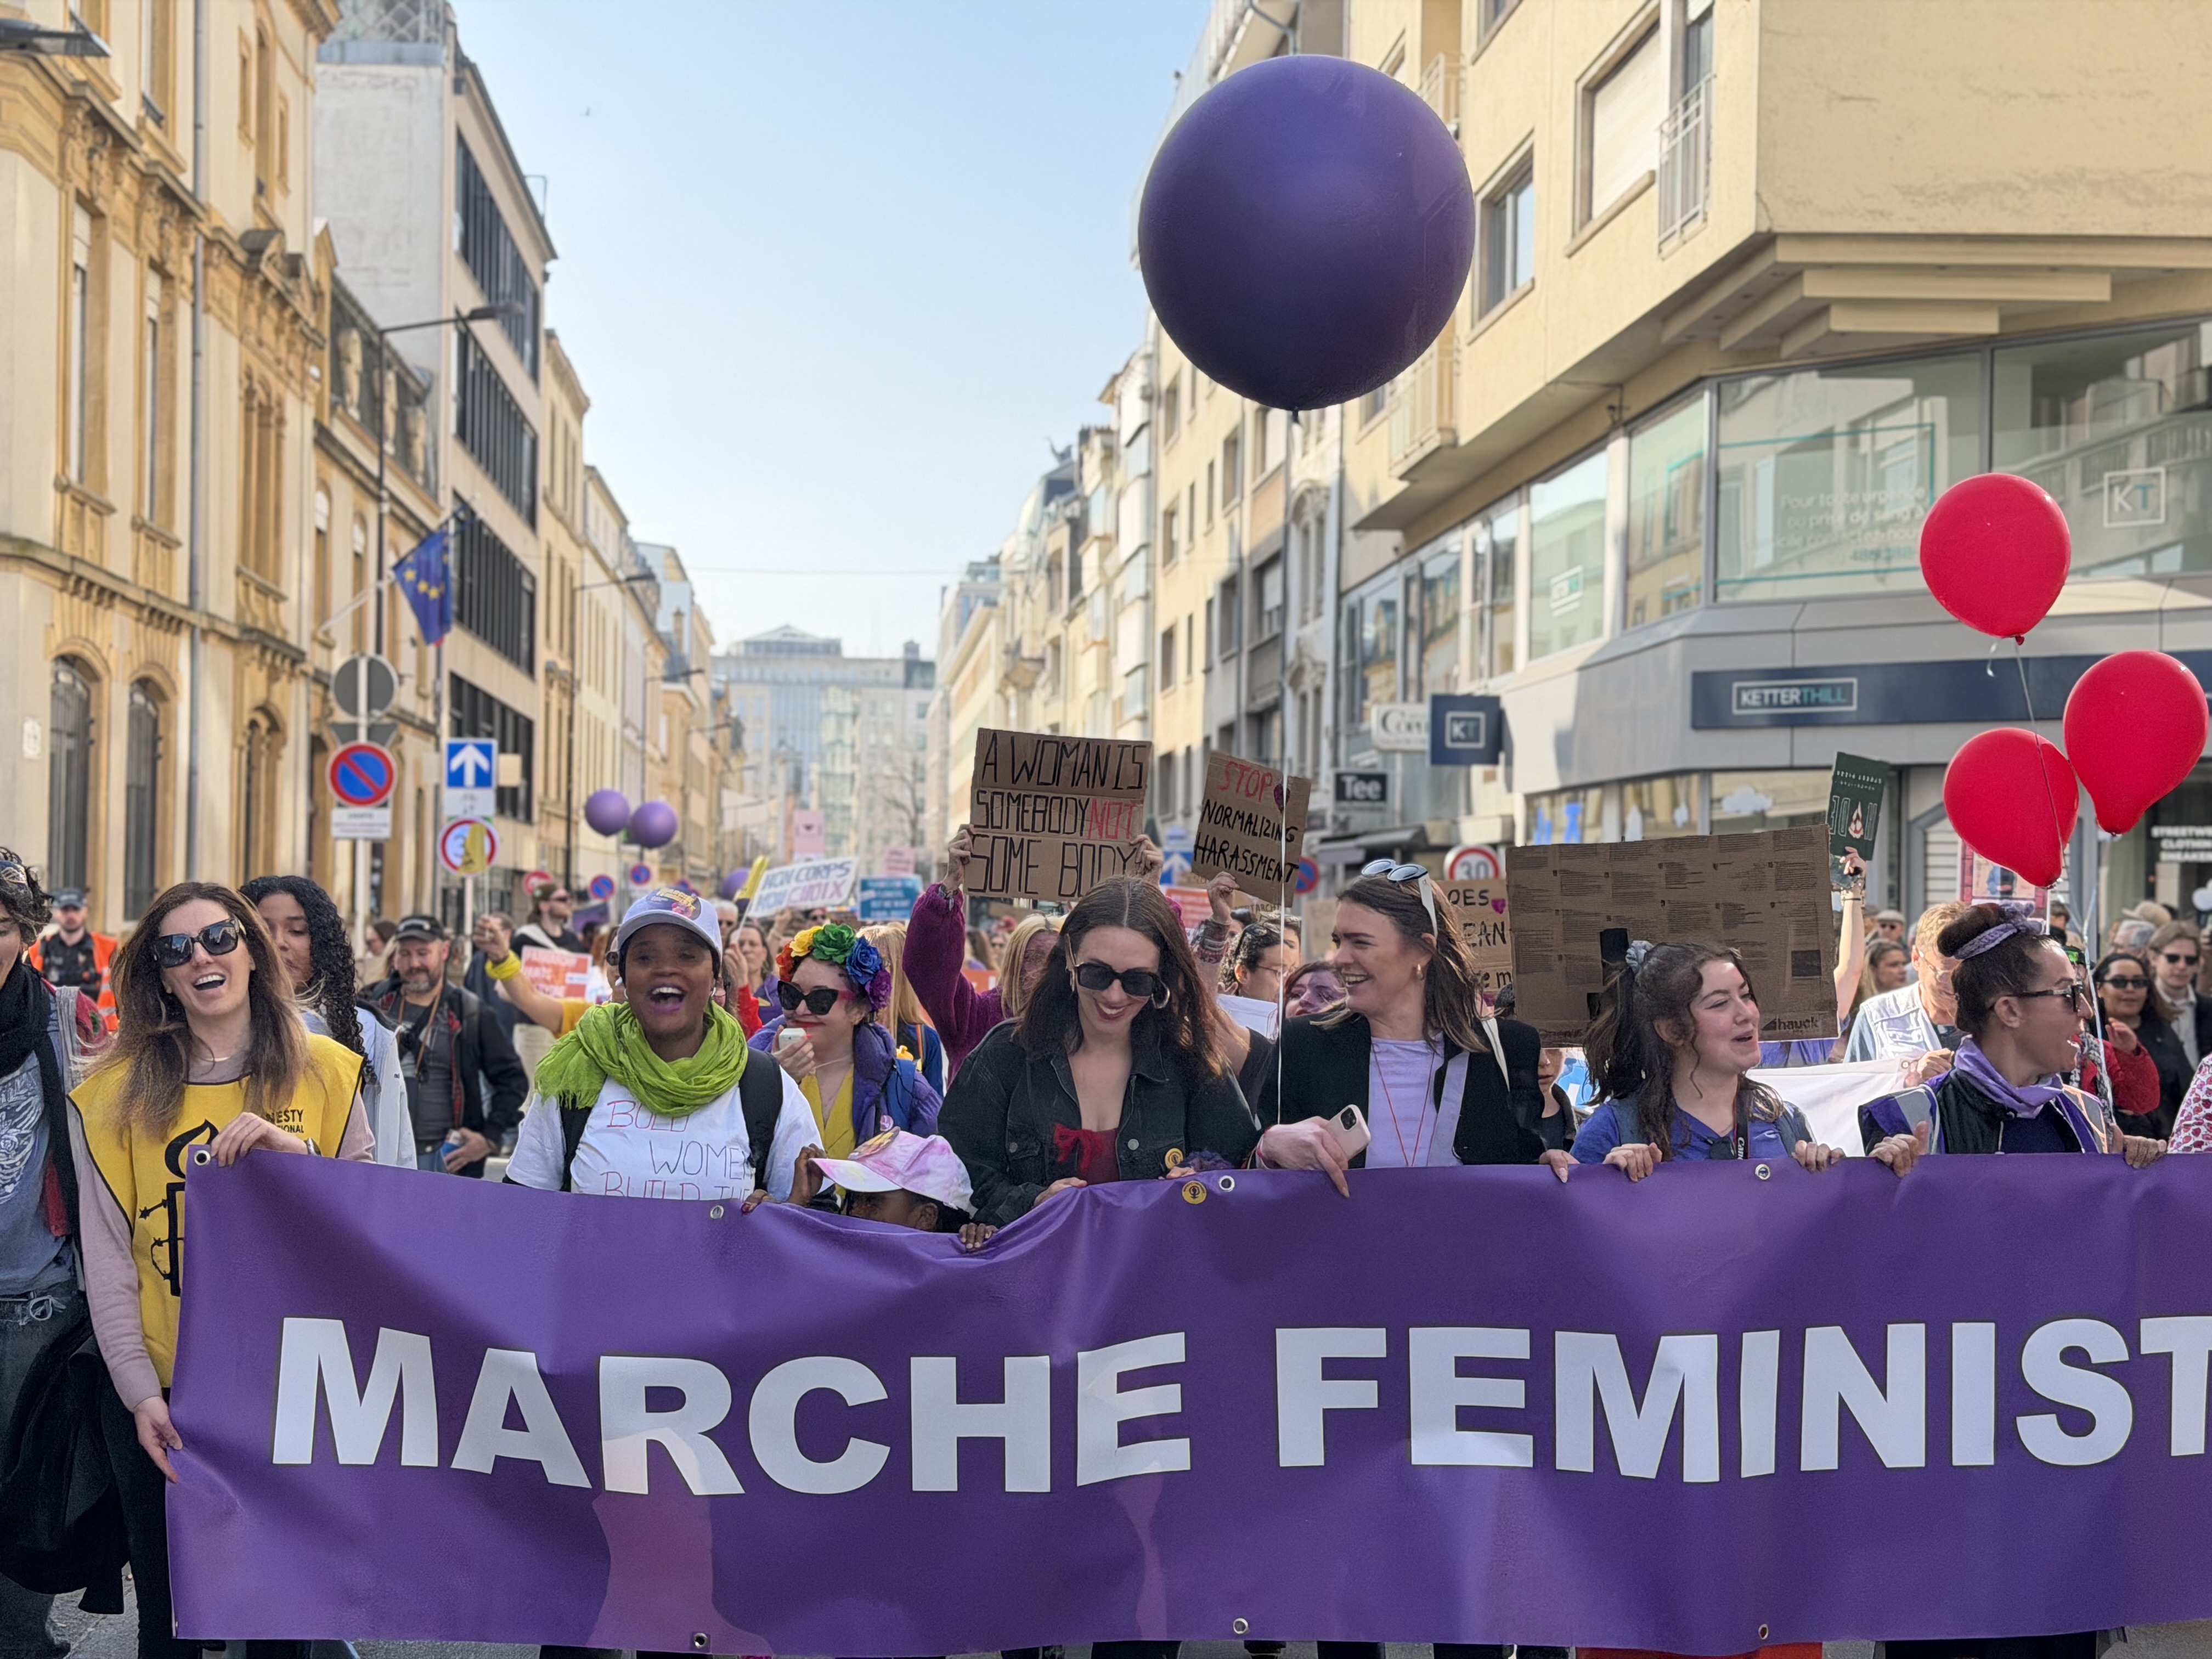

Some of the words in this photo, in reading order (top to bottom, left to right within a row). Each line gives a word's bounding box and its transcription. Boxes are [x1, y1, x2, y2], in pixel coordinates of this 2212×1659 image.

[2114, 483, 2154, 512] KT
[1741, 686, 1848, 707] KETTERTHILL
[1452, 720, 1477, 740] KT
[981, 732, 998, 783] A
[1011, 735, 1111, 789] WOMAN
[1112, 744, 1147, 790] IS
[1216, 761, 1273, 803] STOP
[1341, 775, 1382, 799] Tee
[973, 790, 1090, 837] SOMEBODY
[1088, 798, 1137, 840] NOT
[1201, 799, 1299, 843] NORMALIZING
[967, 833, 1042, 895] SOME
[1058, 841, 1137, 898] BODY
[1194, 832, 1300, 882] HARASSMENT
[795, 861, 853, 883] CORPS
[1459, 861, 1489, 880] 30
[787, 879, 847, 904] CHOIX
[1448, 888, 1489, 906] OES
[1463, 921, 1506, 947] EAN
[266, 1109, 304, 1124] NESTY
[650, 1140, 753, 1180] WOMEN
[1737, 1137, 1745, 1160] Can
[272, 1316, 1191, 1496] MARCHE
[1274, 1317, 2212, 1482] FEMINIST
